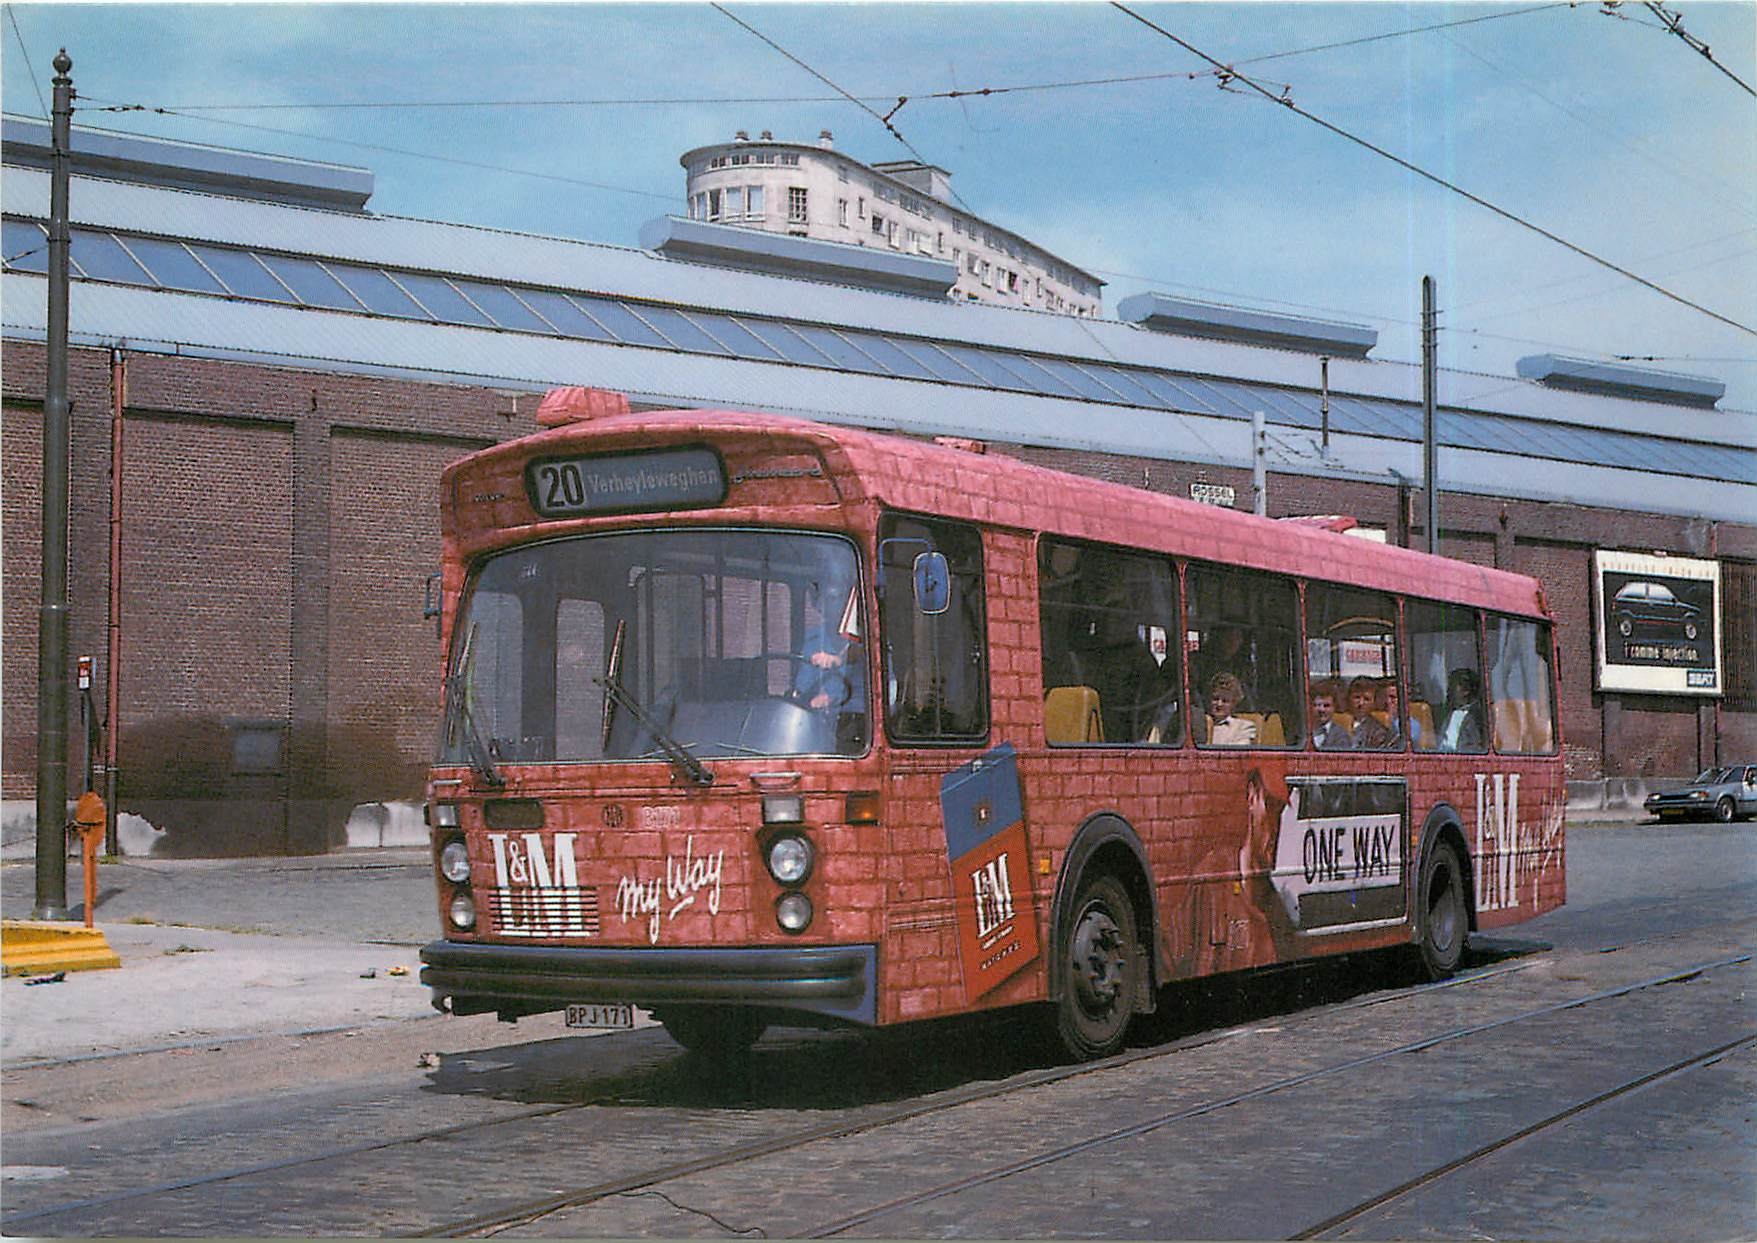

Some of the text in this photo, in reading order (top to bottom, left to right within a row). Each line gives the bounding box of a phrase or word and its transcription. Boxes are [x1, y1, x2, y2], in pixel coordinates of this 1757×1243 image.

[541, 463, 585, 508] 20
[1302, 824, 1395, 885] ONE WAY
[1474, 773, 1521, 912] L&M
[487, 832, 592, 937] L&M
[970, 852, 1016, 939] L&M
[568, 1006, 628, 1025] BPJ 171
